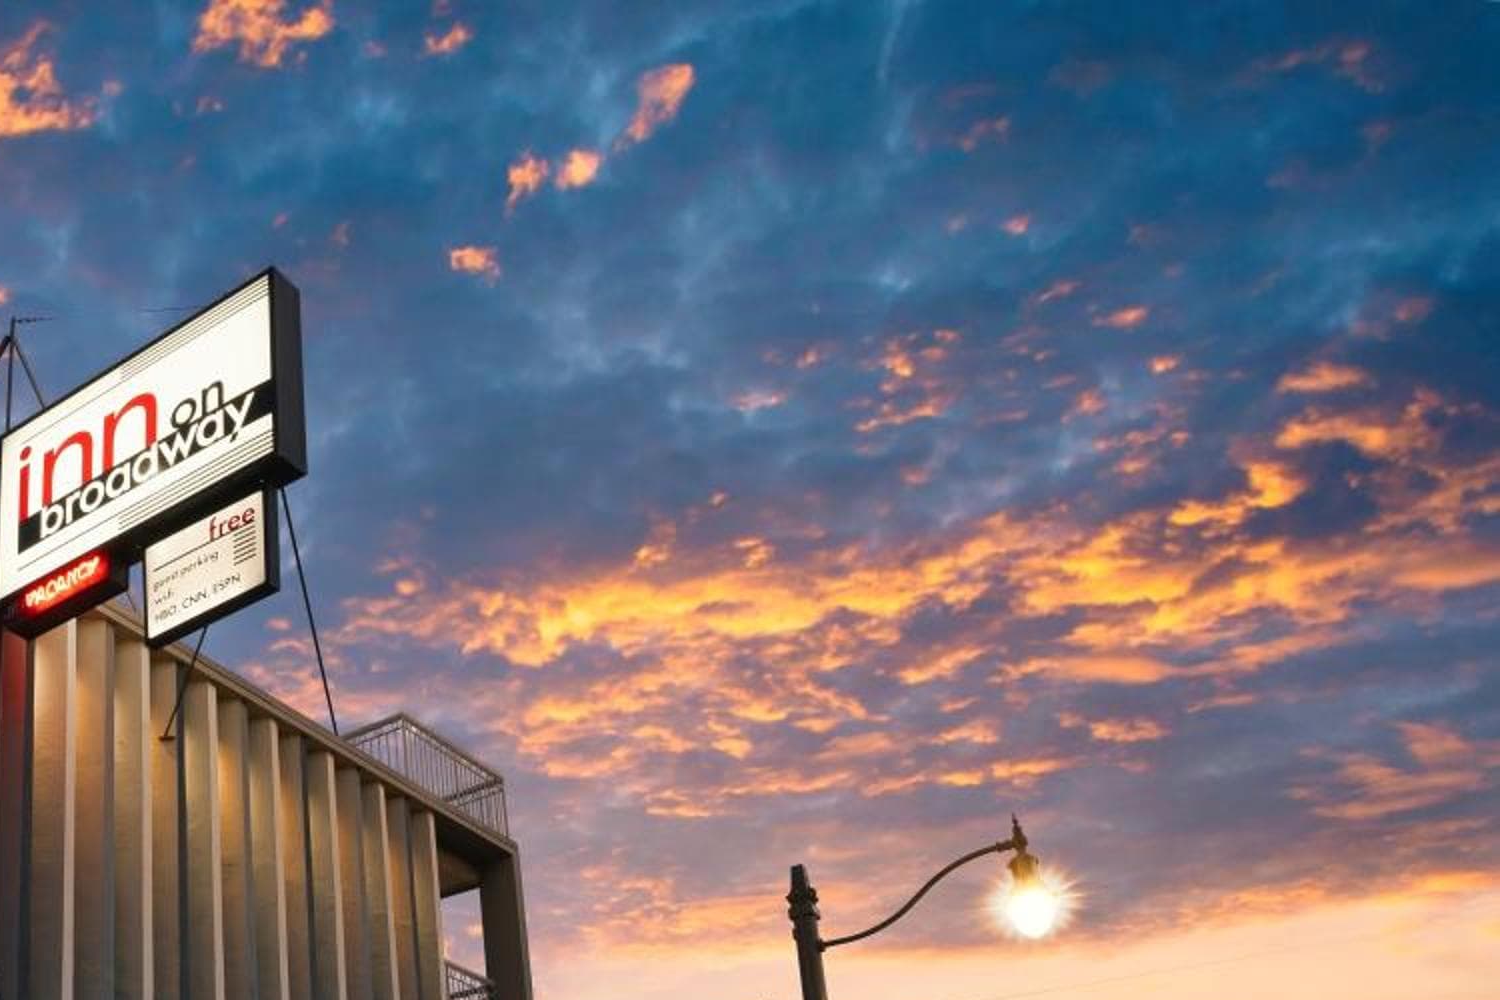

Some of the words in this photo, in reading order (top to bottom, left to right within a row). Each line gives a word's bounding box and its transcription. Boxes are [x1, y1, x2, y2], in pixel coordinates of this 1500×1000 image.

[18, 392, 158, 523] inn
[171, 380, 224, 429] on
[39, 391, 255, 539] broadway
[209, 507, 255, 541] free
